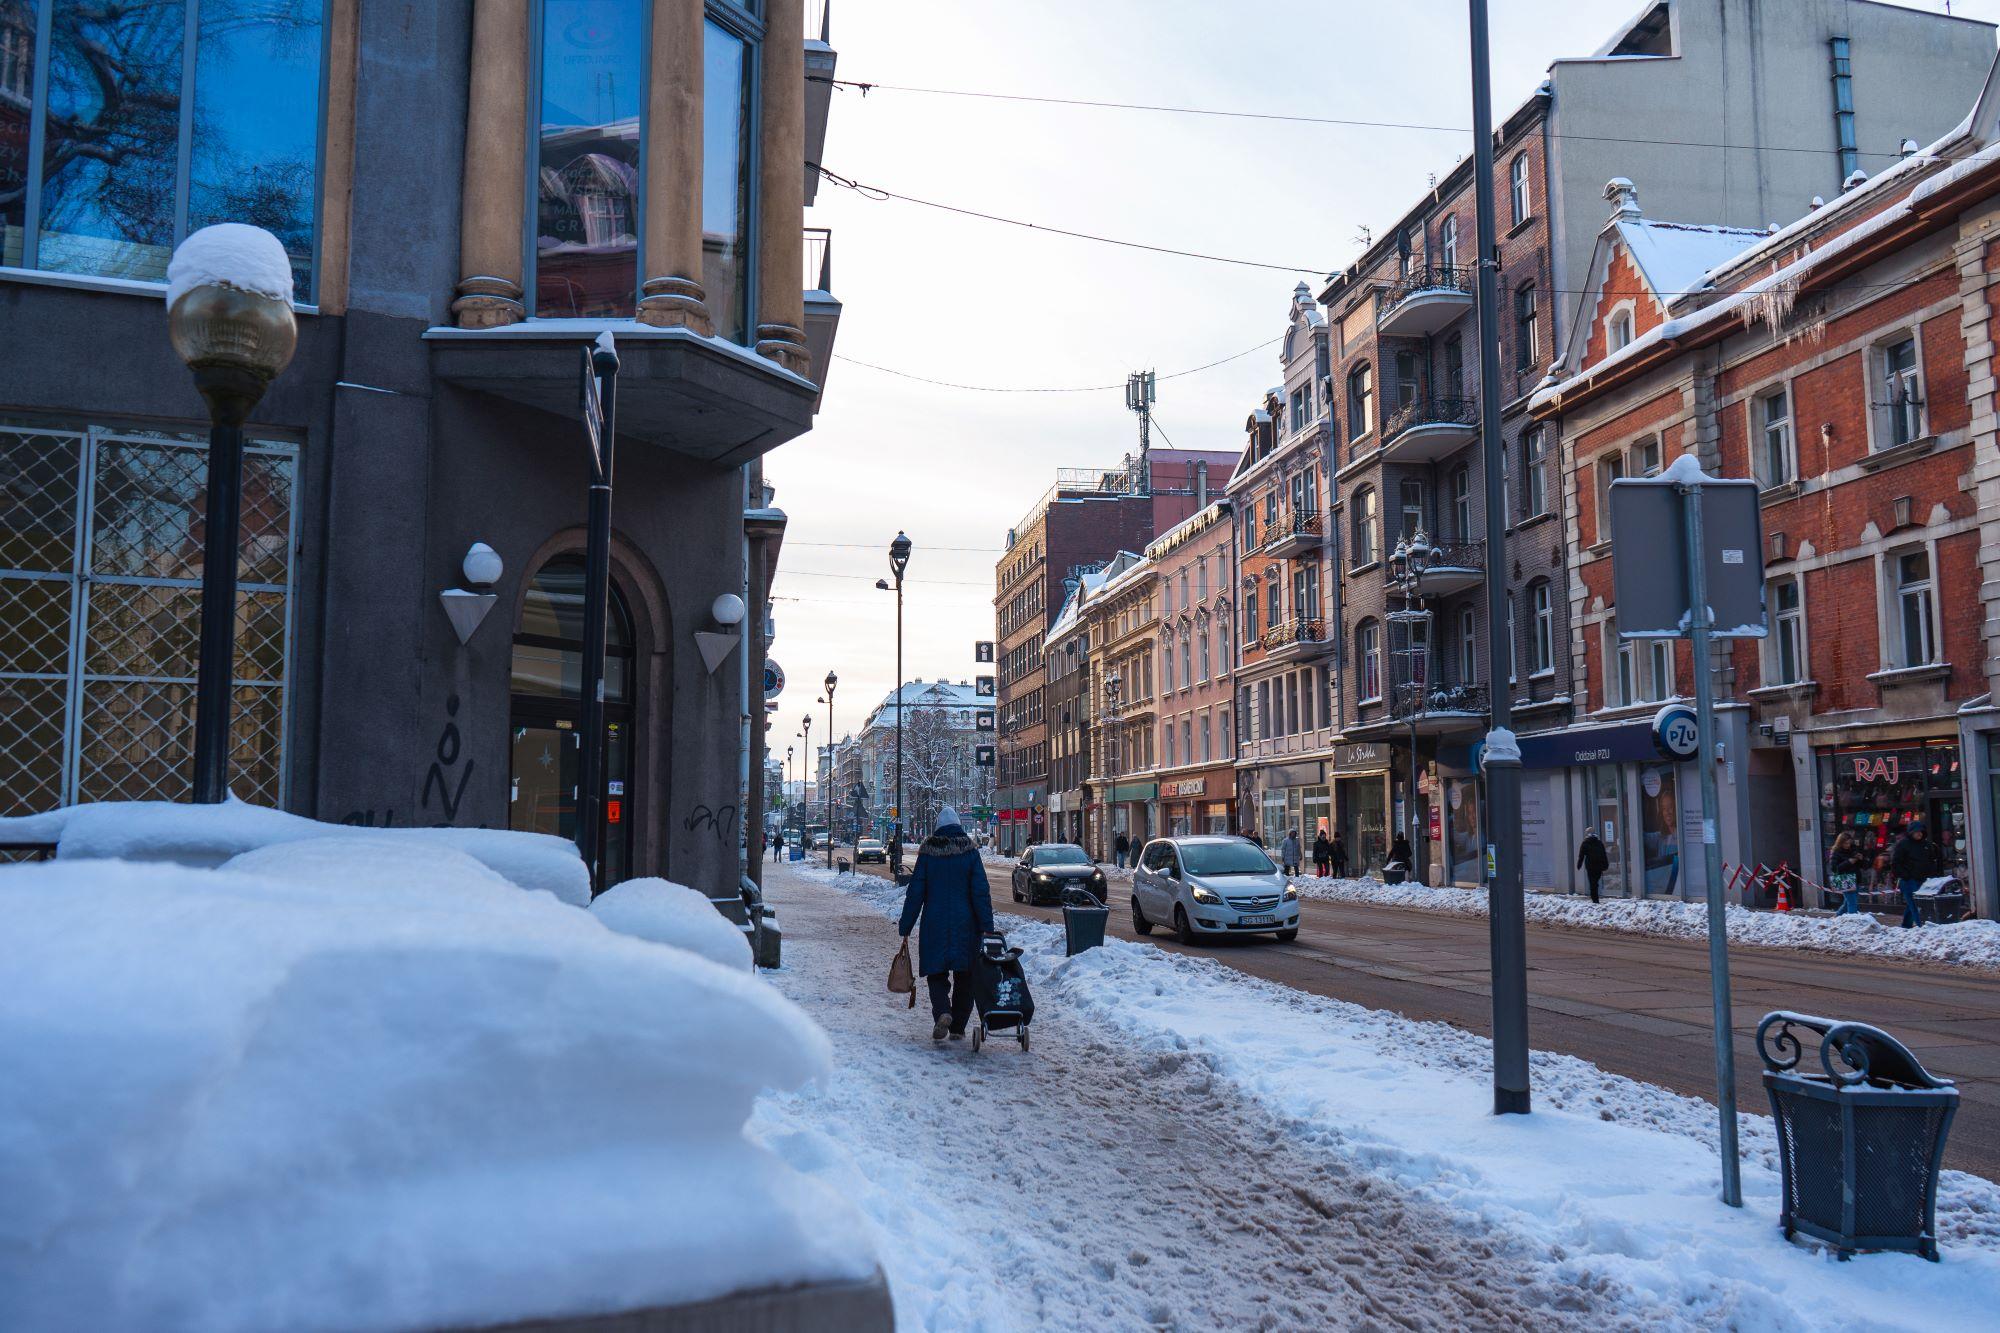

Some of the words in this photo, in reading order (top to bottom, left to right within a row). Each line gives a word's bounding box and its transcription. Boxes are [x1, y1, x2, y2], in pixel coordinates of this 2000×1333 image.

[1669, 724, 1696, 747] PZU
[1597, 748, 1610, 759] PZU
[1853, 756, 1900, 785] RAJ
